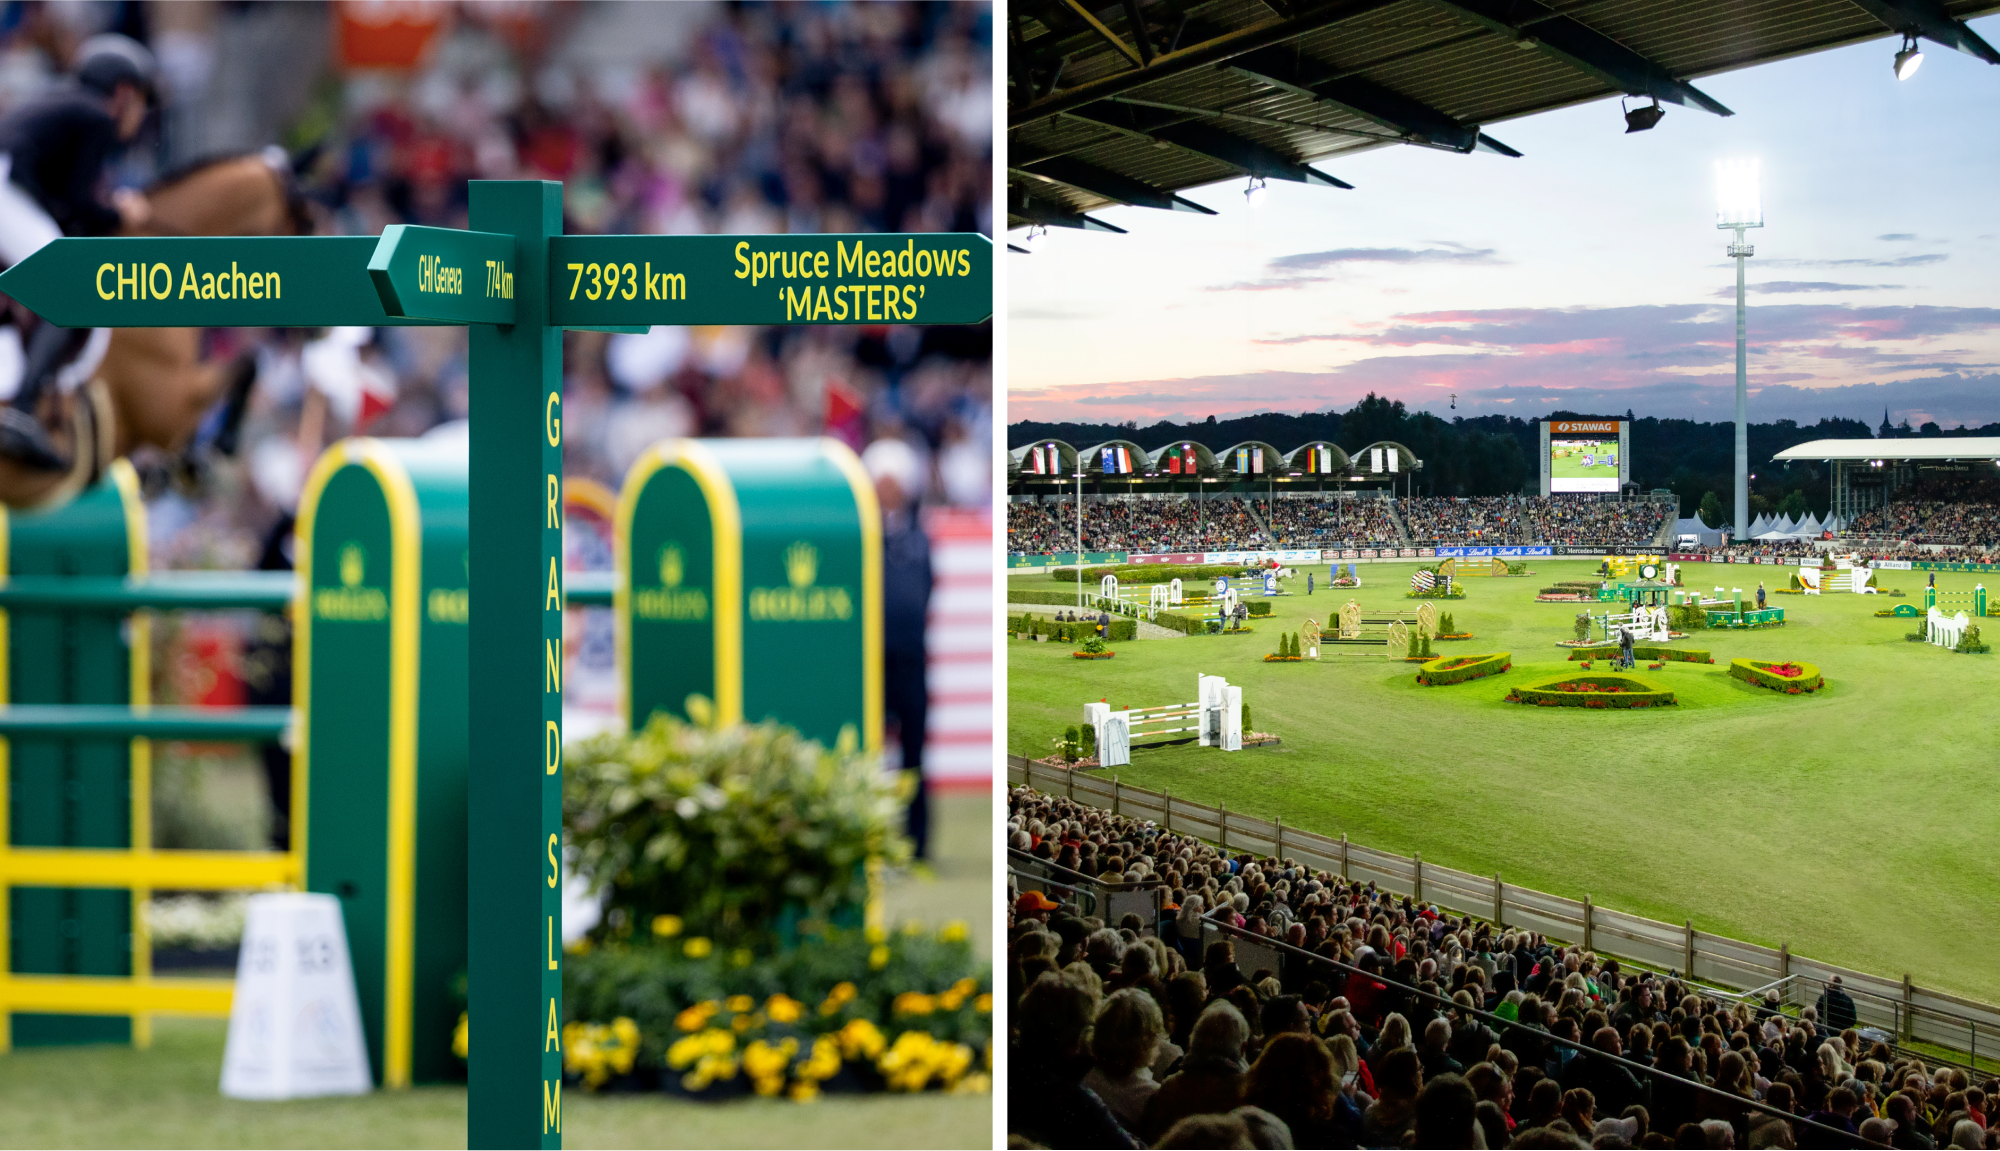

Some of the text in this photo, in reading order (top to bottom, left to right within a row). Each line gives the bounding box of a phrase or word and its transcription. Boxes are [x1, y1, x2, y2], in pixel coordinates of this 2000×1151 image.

[96, 261, 281, 301] CHIO Aachen
[418, 254, 462, 296] CHI Geneva
[486, 260, 514, 299] 774 km
[567, 261, 686, 301] 7393 km
[734, 238, 971, 287] Spruce Meadows
[1571, 423, 1612, 431] STAWAG
[1438, 548, 1458, 556] Lindt
[1467, 548, 1488, 556] Lindt
[1496, 547, 1517, 556] Lindt
[1525, 547, 1546, 555] Lindt
[545, 391, 561, 777] GRAND
[543, 833, 561, 1136] SLAM
